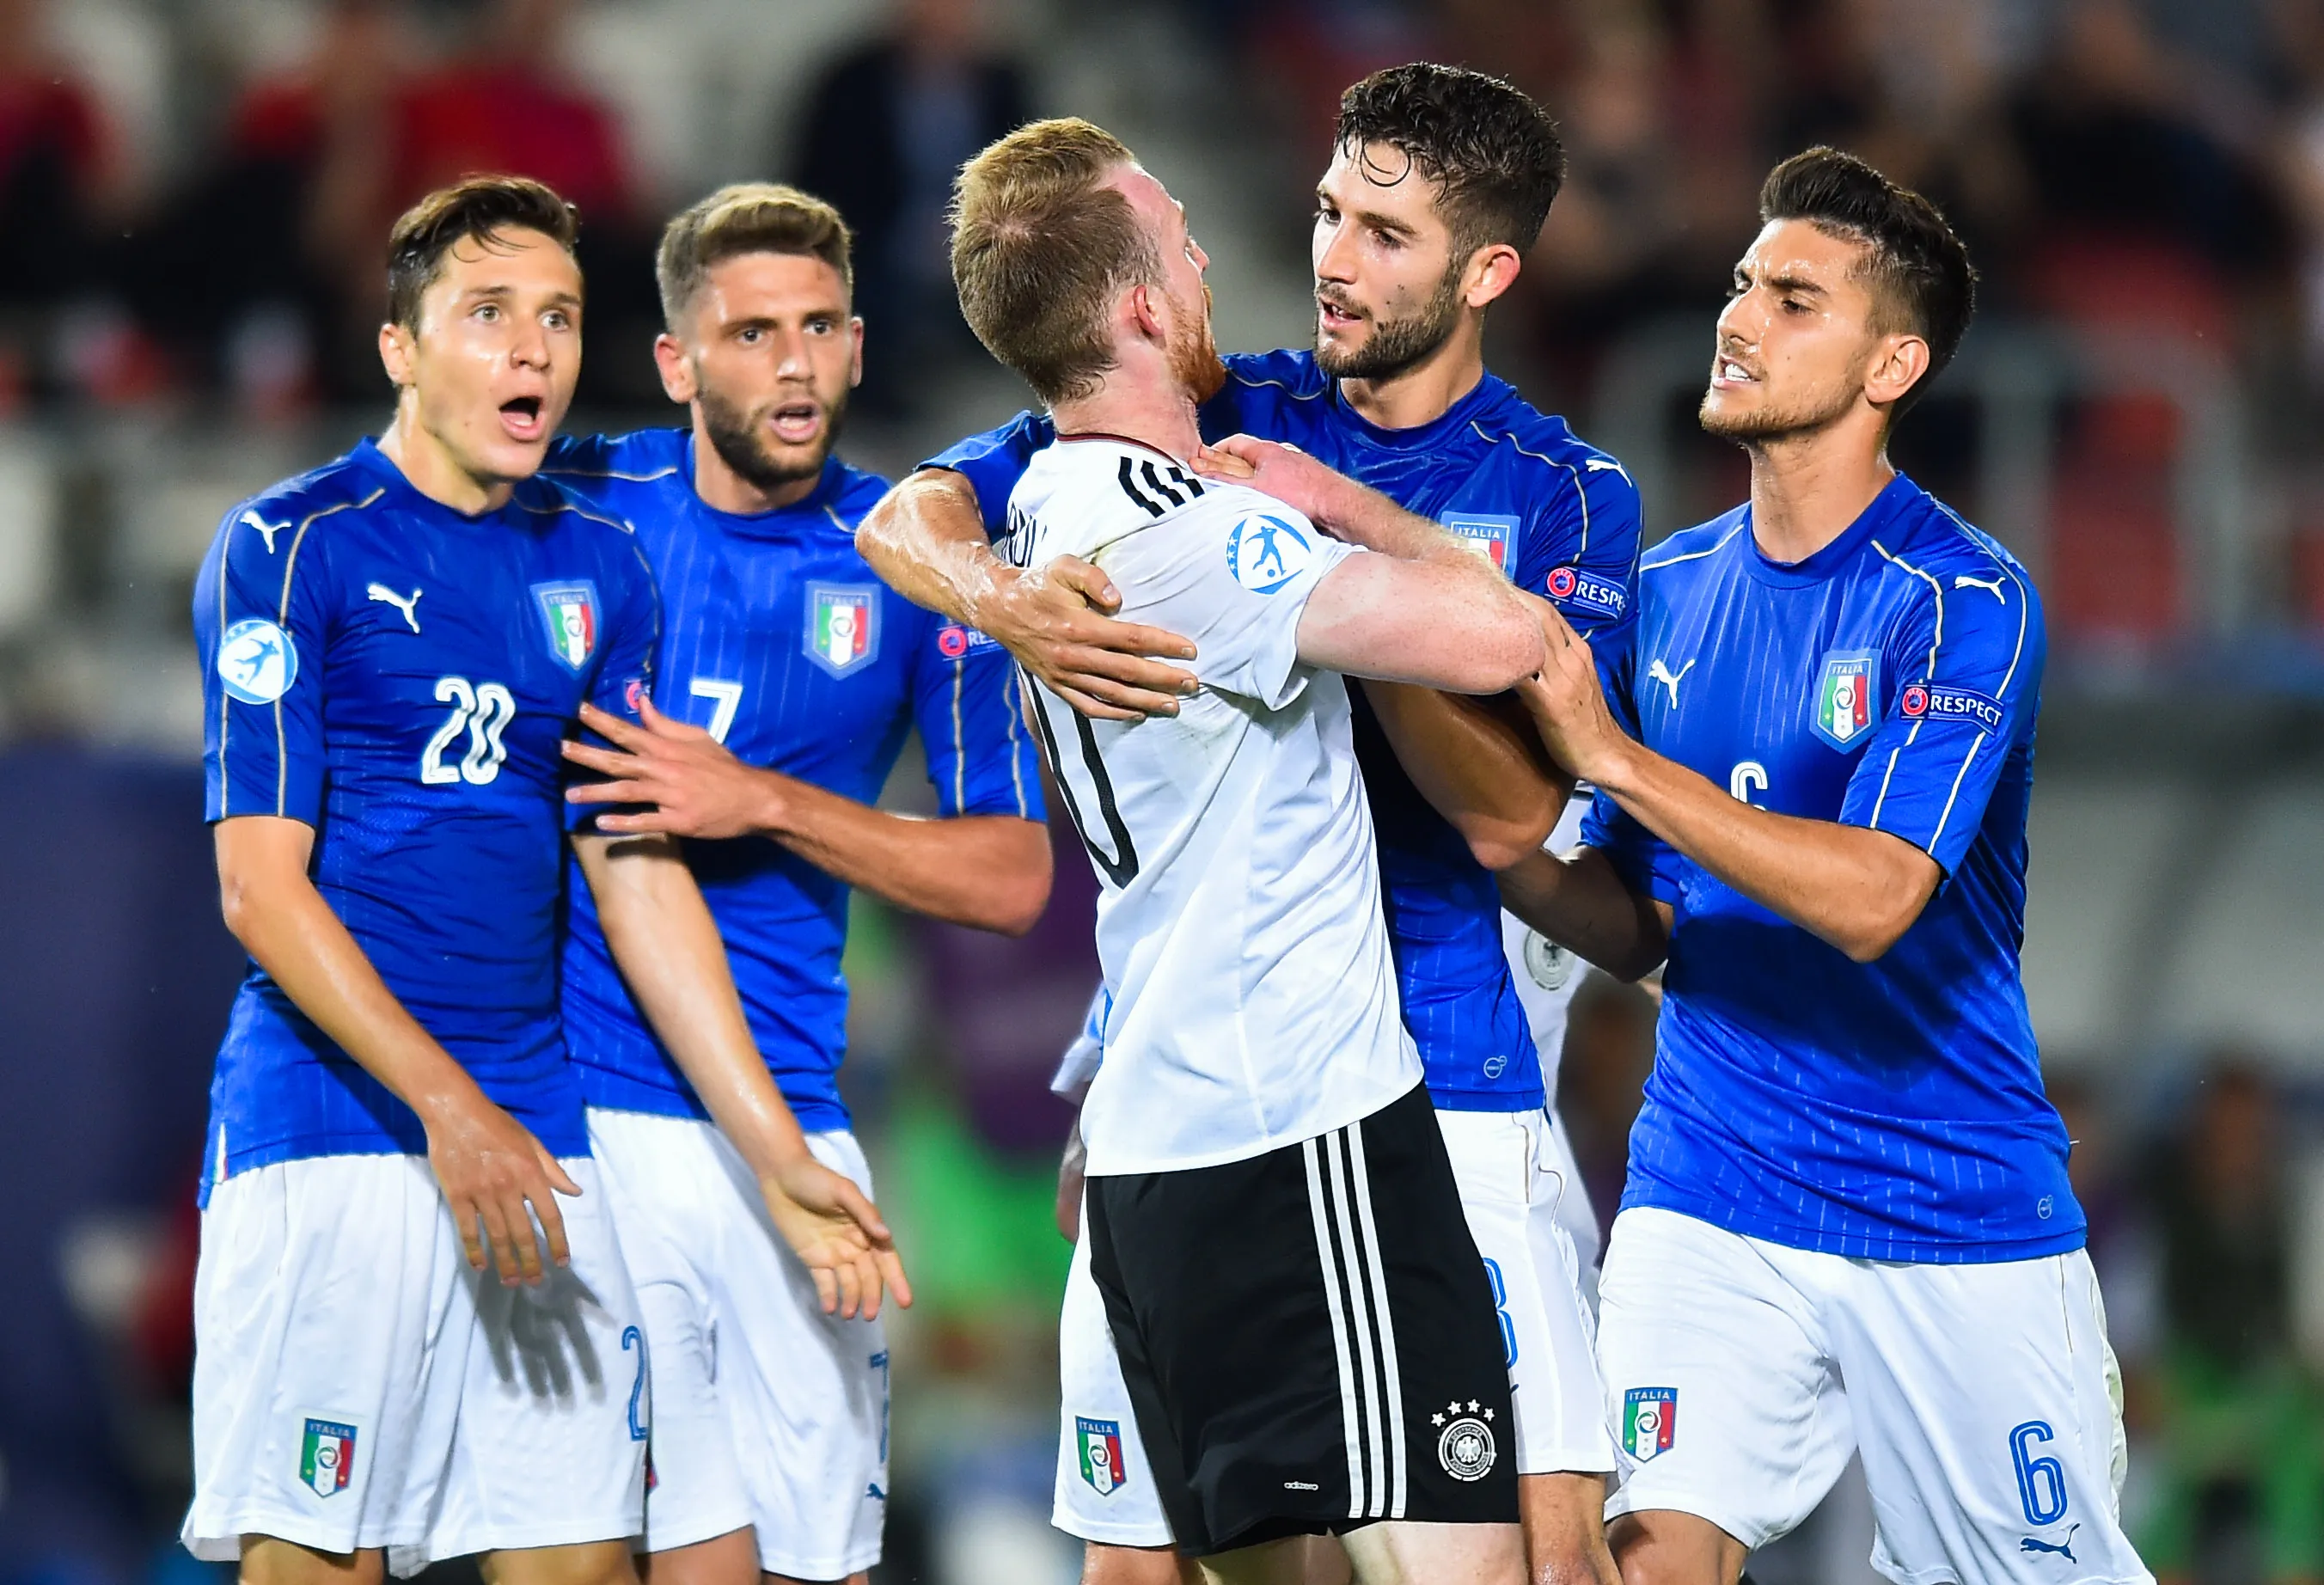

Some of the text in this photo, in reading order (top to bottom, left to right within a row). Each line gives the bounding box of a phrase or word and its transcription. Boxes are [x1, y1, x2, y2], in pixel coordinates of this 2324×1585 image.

[1458, 526, 1501, 540] ITALIA
[1832, 664, 1863, 675] ITALIA
[1930, 695, 2003, 726] RESPECT
[420, 676, 516, 786] 20
[1630, 1391, 1670, 1402] ITALIA
[309, 1423, 351, 1437] ITALIA
[1079, 1421, 1113, 1434] ITALIA
[2009, 1420, 2070, 1527] 6
